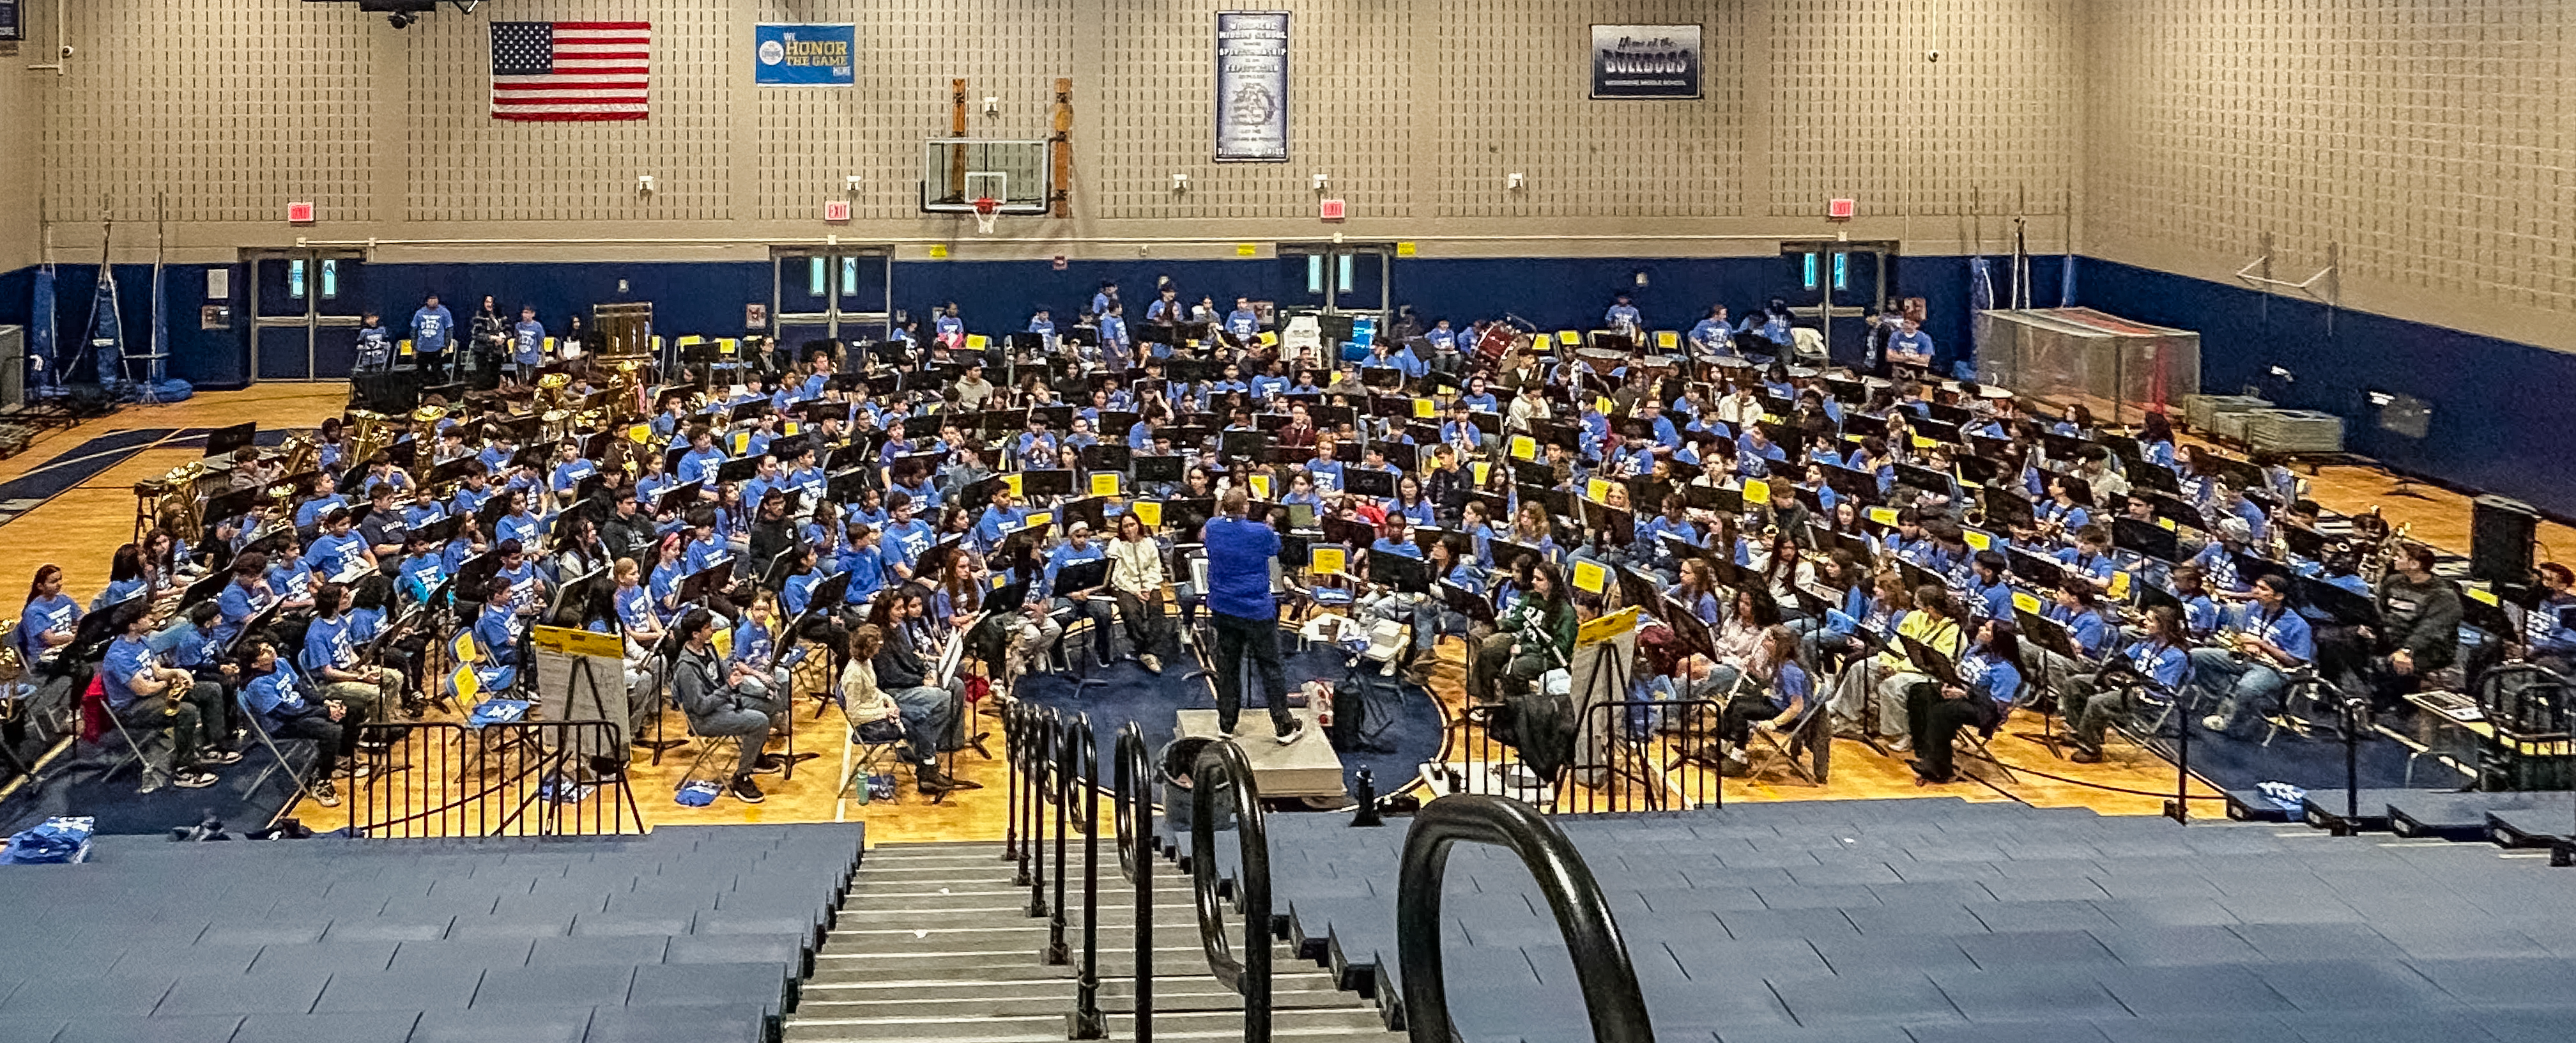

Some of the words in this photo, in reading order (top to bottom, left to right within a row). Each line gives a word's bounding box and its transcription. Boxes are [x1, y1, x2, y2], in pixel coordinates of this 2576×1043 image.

[785, 41, 847, 55] HONOR
[786, 56, 809, 66] THE
[813, 56, 848, 66] GAME
[1602, 49, 1689, 74] BULLDOGS
[829, 204, 847, 218] EXIT
